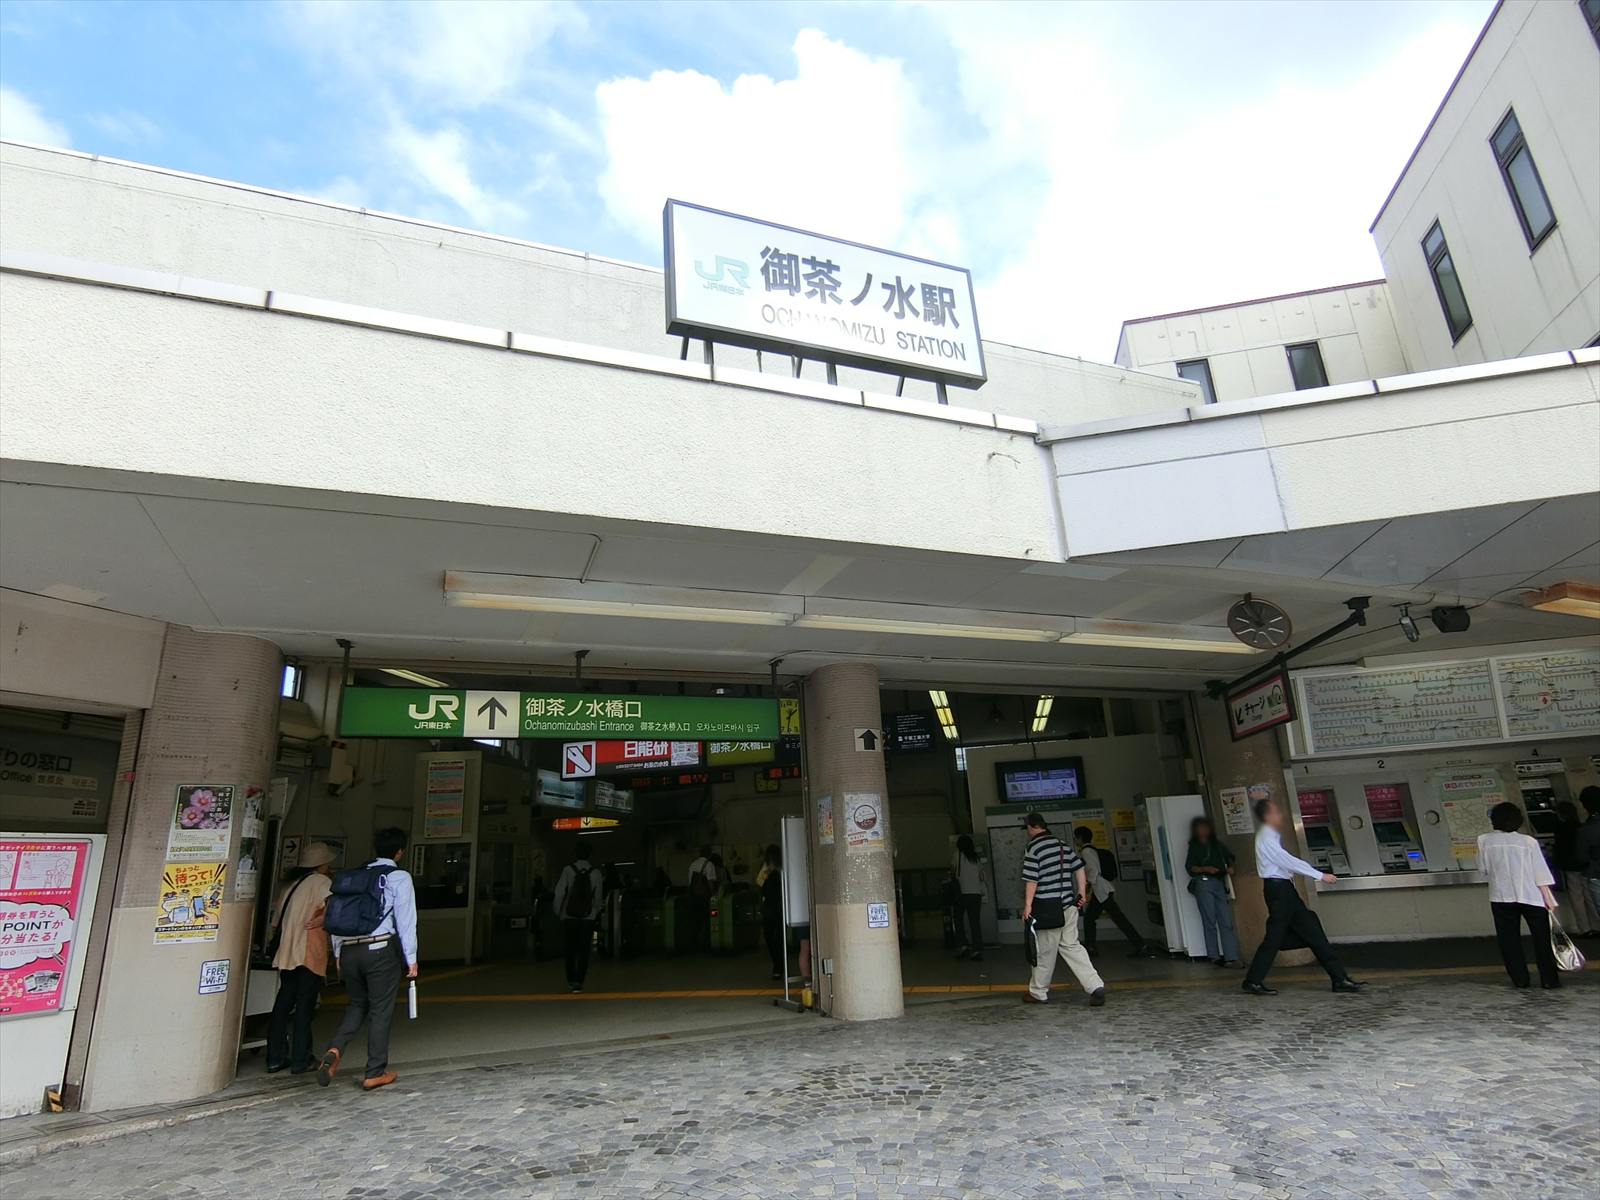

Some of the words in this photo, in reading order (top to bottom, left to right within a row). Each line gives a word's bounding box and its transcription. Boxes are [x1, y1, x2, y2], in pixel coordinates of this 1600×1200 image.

[694, 255, 751, 289] JR
[702, 282, 745, 297] JR東日本
[760, 245, 960, 329] 御茶ノ水駅
[896, 331, 967, 361] STATION
[408, 694, 460, 720] JR
[525, 697, 642, 718] 御茶ノ水橋口
[1244, 695, 1265, 716] チャージ
[414, 721, 452, 730] JR東日本
[524, 719, 598, 732] Ochanomizubashi
[599, 720, 634, 732] Entrance
[624, 740, 669, 759] 日能研
[710, 742, 772, 754] 御茶ノ水橋口
[1531, 748, 1539, 757] 4
[1303, 765, 1310, 774] 1
[1377, 760, 1386, 769] 2
[0, 770, 33, 783] Office
[552, 819, 559, 829] 4
[175, 865, 200, 873] ちょっと
[174, 869, 213, 885] 待って!
[870, 907, 885, 915] FREE
[206, 967, 225, 976] FREE
[205, 976, 224, 984] Wi-Fi
